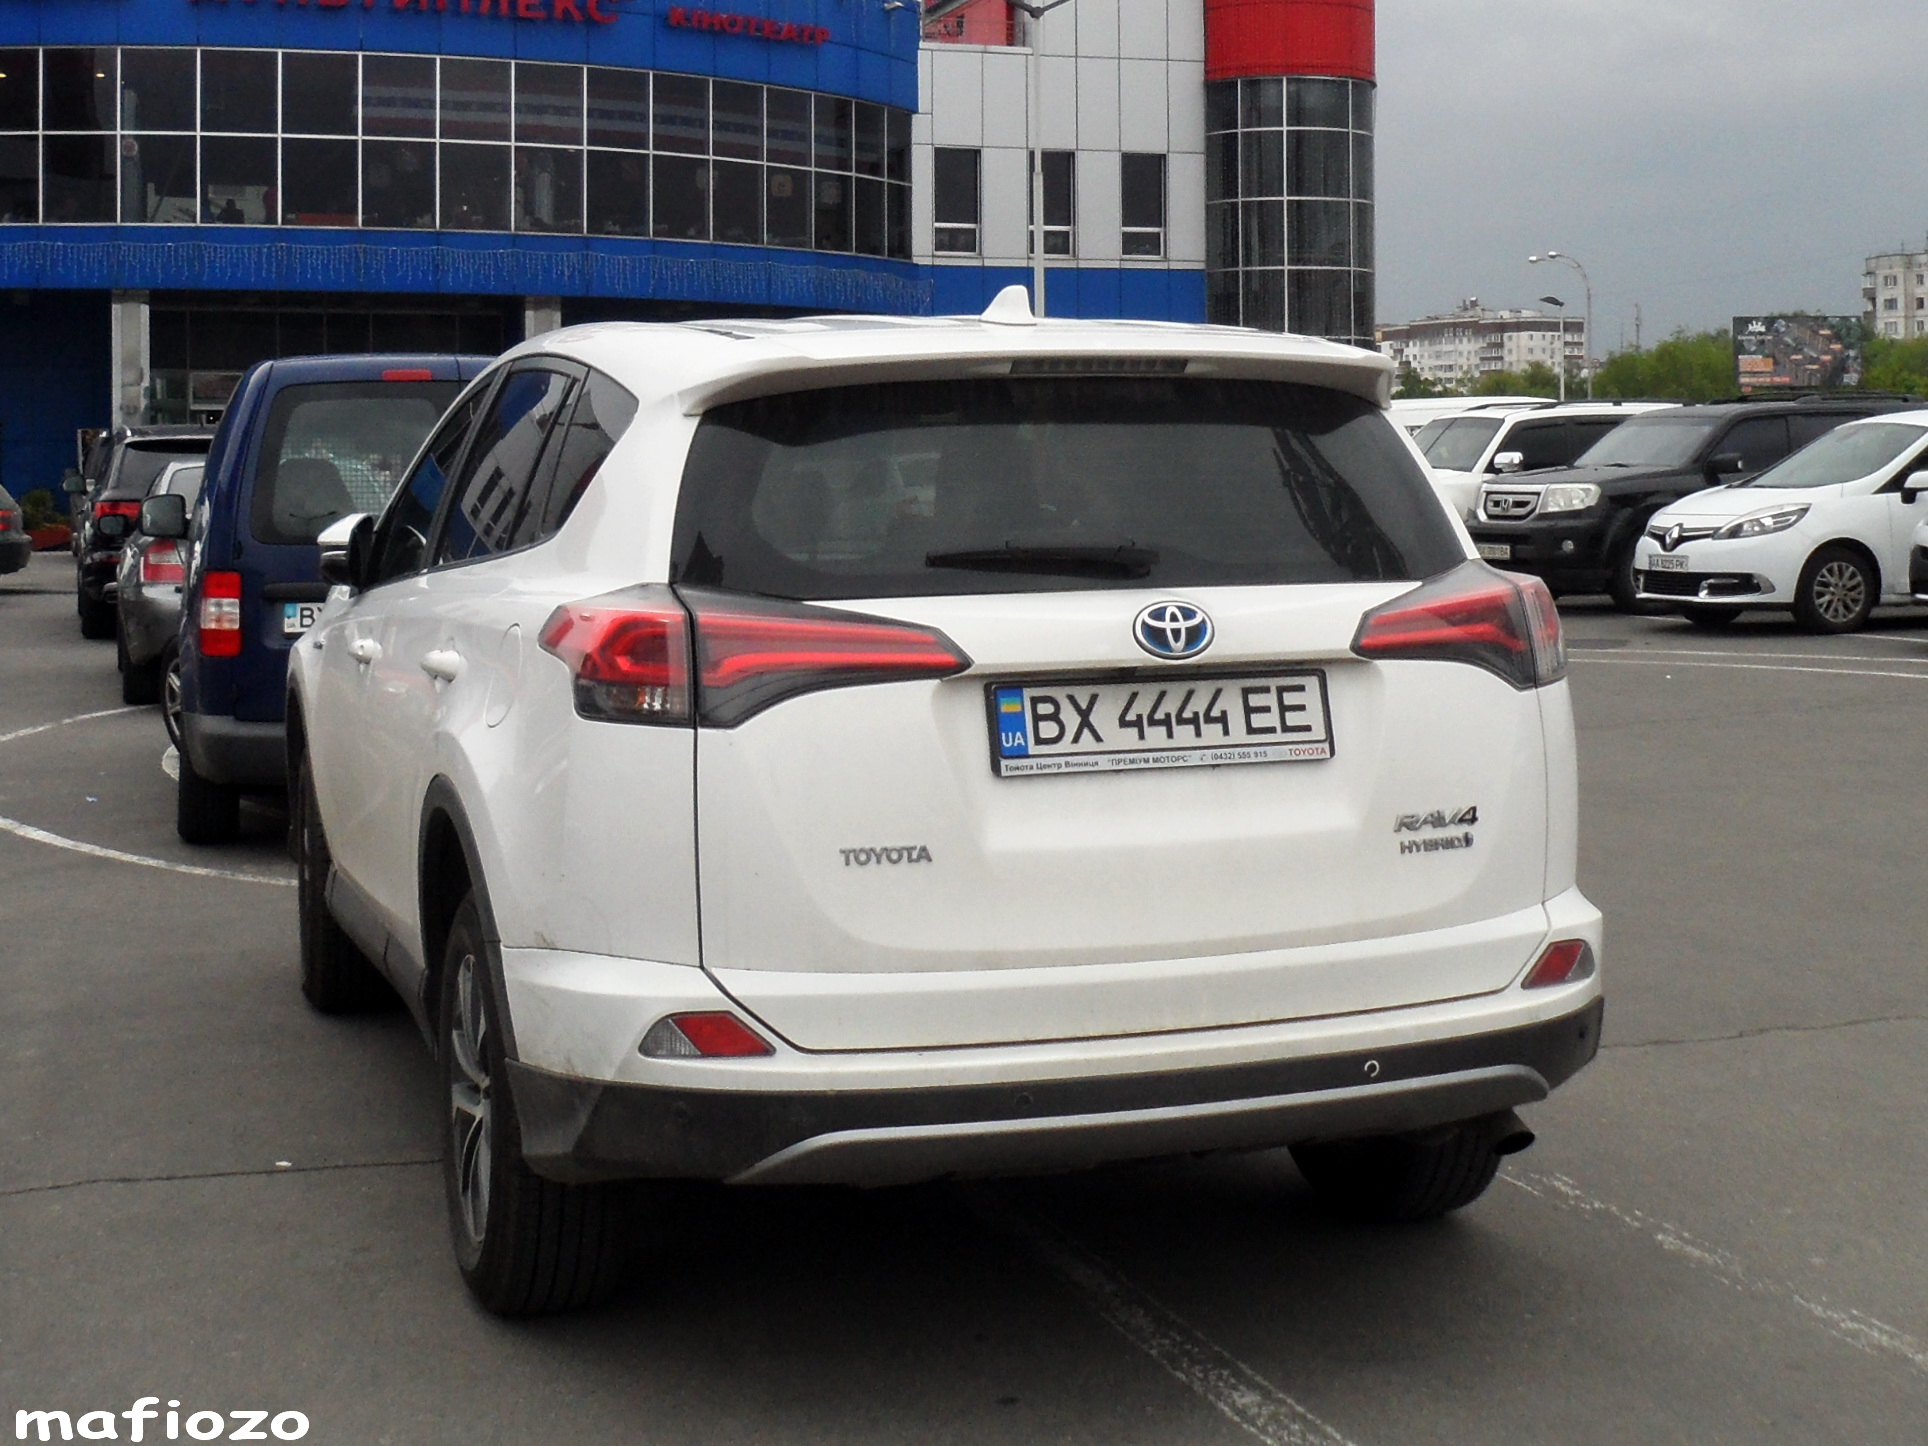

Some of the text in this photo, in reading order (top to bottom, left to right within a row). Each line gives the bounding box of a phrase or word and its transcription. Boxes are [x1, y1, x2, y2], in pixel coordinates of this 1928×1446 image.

[668, 5, 831, 46] КІНОТЕАТР
[300, 606, 322, 628] B
[1029, 684, 1313, 746] BX 4444 EE
[1001, 731, 1025, 748] UA
[1288, 746, 1327, 757] TOYOTA
[1004, 763, 1034, 772] Тойота
[1036, 762, 1063, 771] Центр
[1064, 760, 1099, 769] Вінниця
[1393, 805, 1478, 833] RAV4
[1400, 835, 1464, 854] HYBRID
[839, 845, 932, 866] TOYOTA
